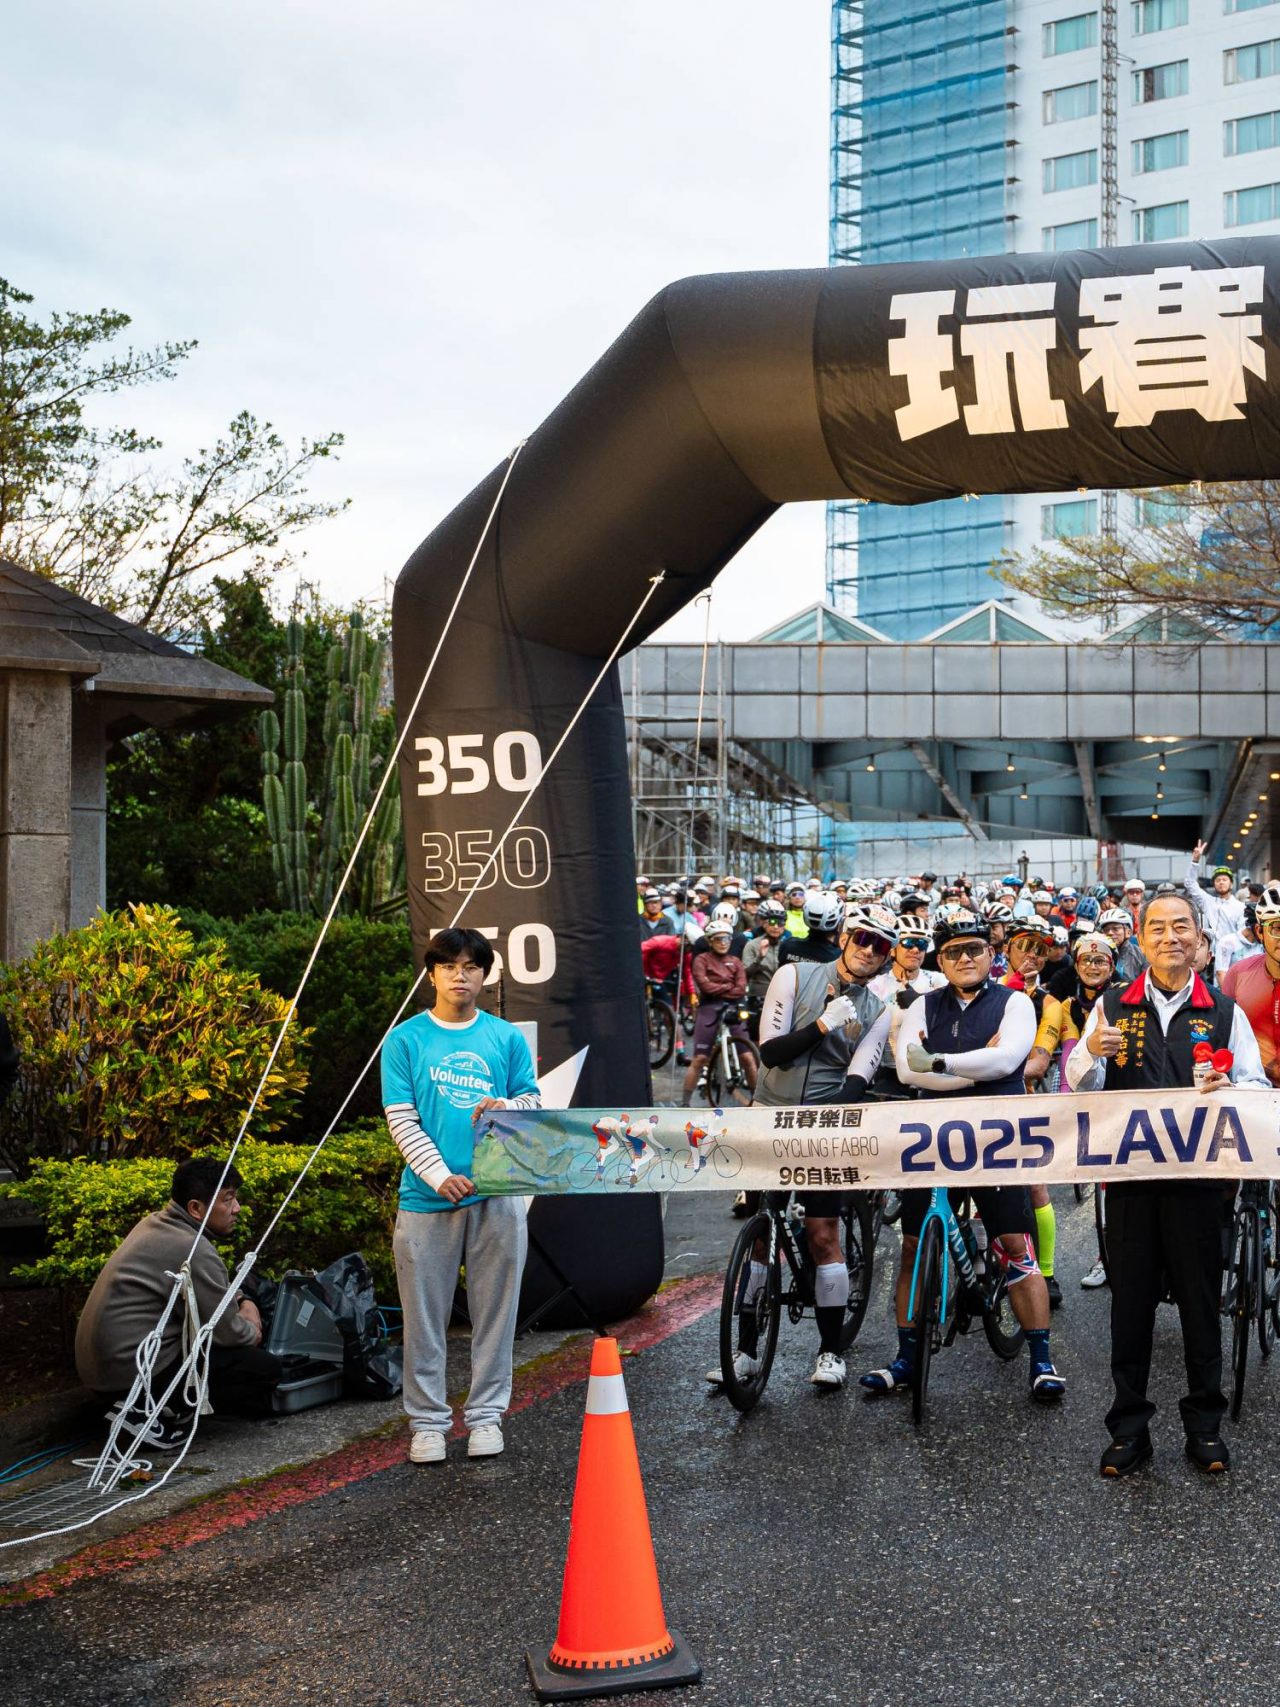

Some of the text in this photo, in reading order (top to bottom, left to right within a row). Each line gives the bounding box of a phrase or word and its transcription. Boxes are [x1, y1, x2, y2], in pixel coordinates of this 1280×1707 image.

[414, 730, 543, 796] 350
[422, 825, 551, 892] 350
[430, 923, 557, 986] 50
[774, 1000, 783, 1031] MAAP
[870, 1042, 882, 1070] MAAP
[430, 1066, 494, 1092] Volunteer
[773, 1108, 863, 1129] 玩賽樂園
[772, 1136, 879, 1158] CYCLING FABRO
[899, 1116, 1055, 1172] 2025
[1076, 1105, 1254, 1167] LAVA
[779, 1166, 861, 1186] 96自転車
